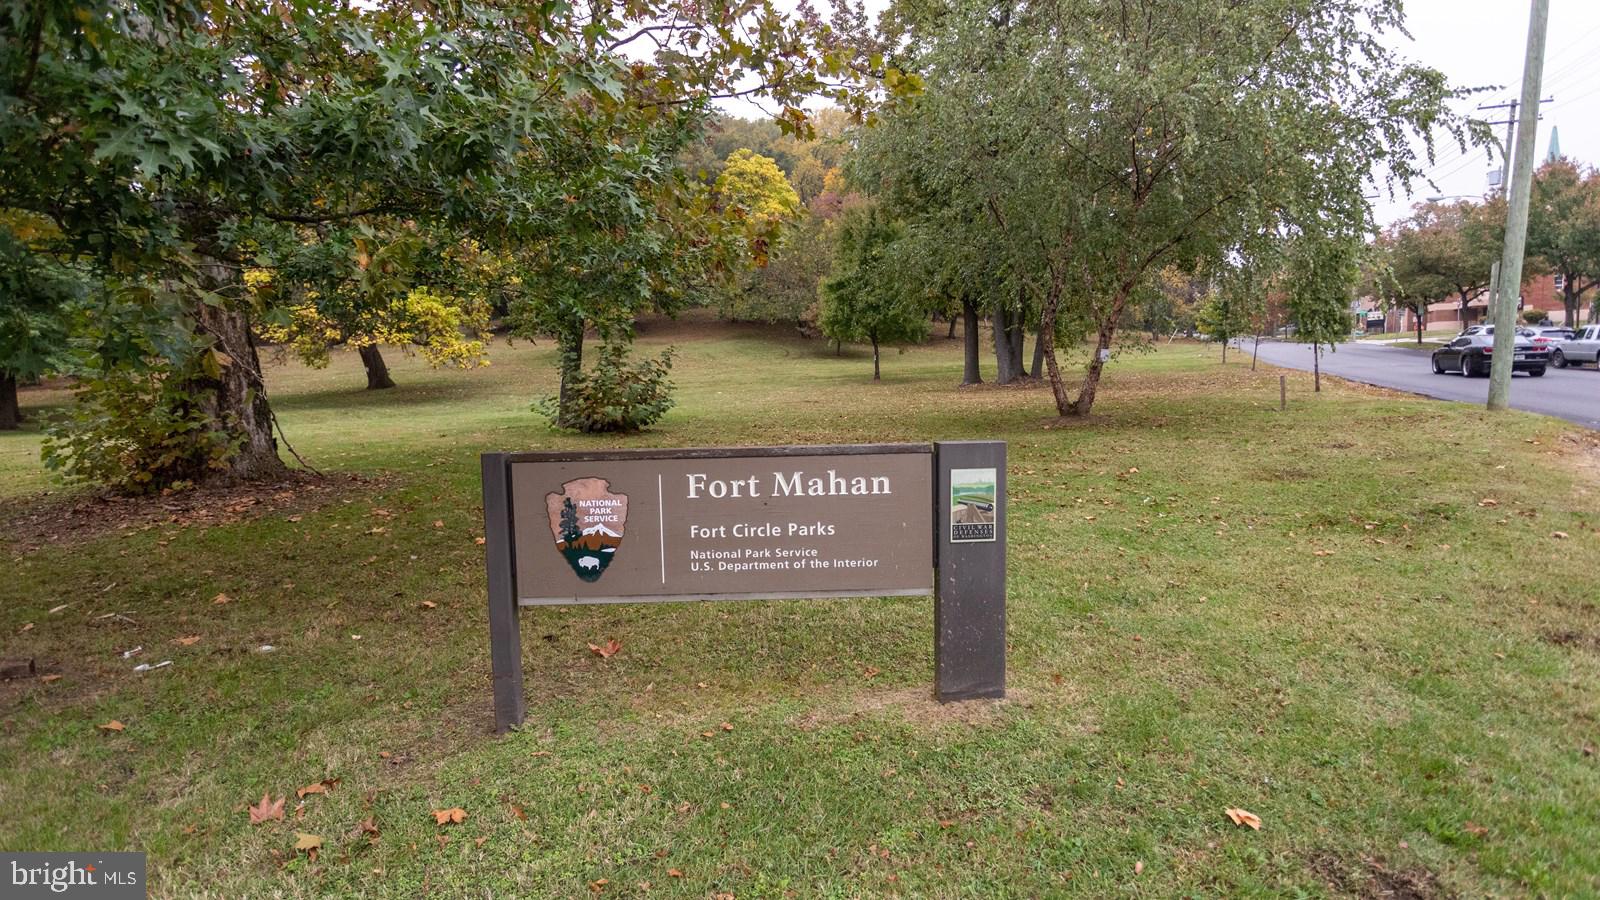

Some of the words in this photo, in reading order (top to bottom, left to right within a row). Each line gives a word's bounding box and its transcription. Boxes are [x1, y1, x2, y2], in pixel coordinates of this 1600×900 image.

[686, 473, 761, 499] Fort
[771, 469, 892, 497] Mahan
[690, 525, 727, 538] Fort
[732, 522, 782, 538] Circle
[788, 521, 836, 536] Parks
[690, 549, 741, 560] National
[745, 548, 771, 558] Park
[775, 547, 818, 558] Service
[690, 561, 714, 572] U.S.
[718, 559, 791, 573] Department
[793, 558, 806, 569] of
[810, 558, 830, 569] the
[833, 558, 879, 568] Interior
